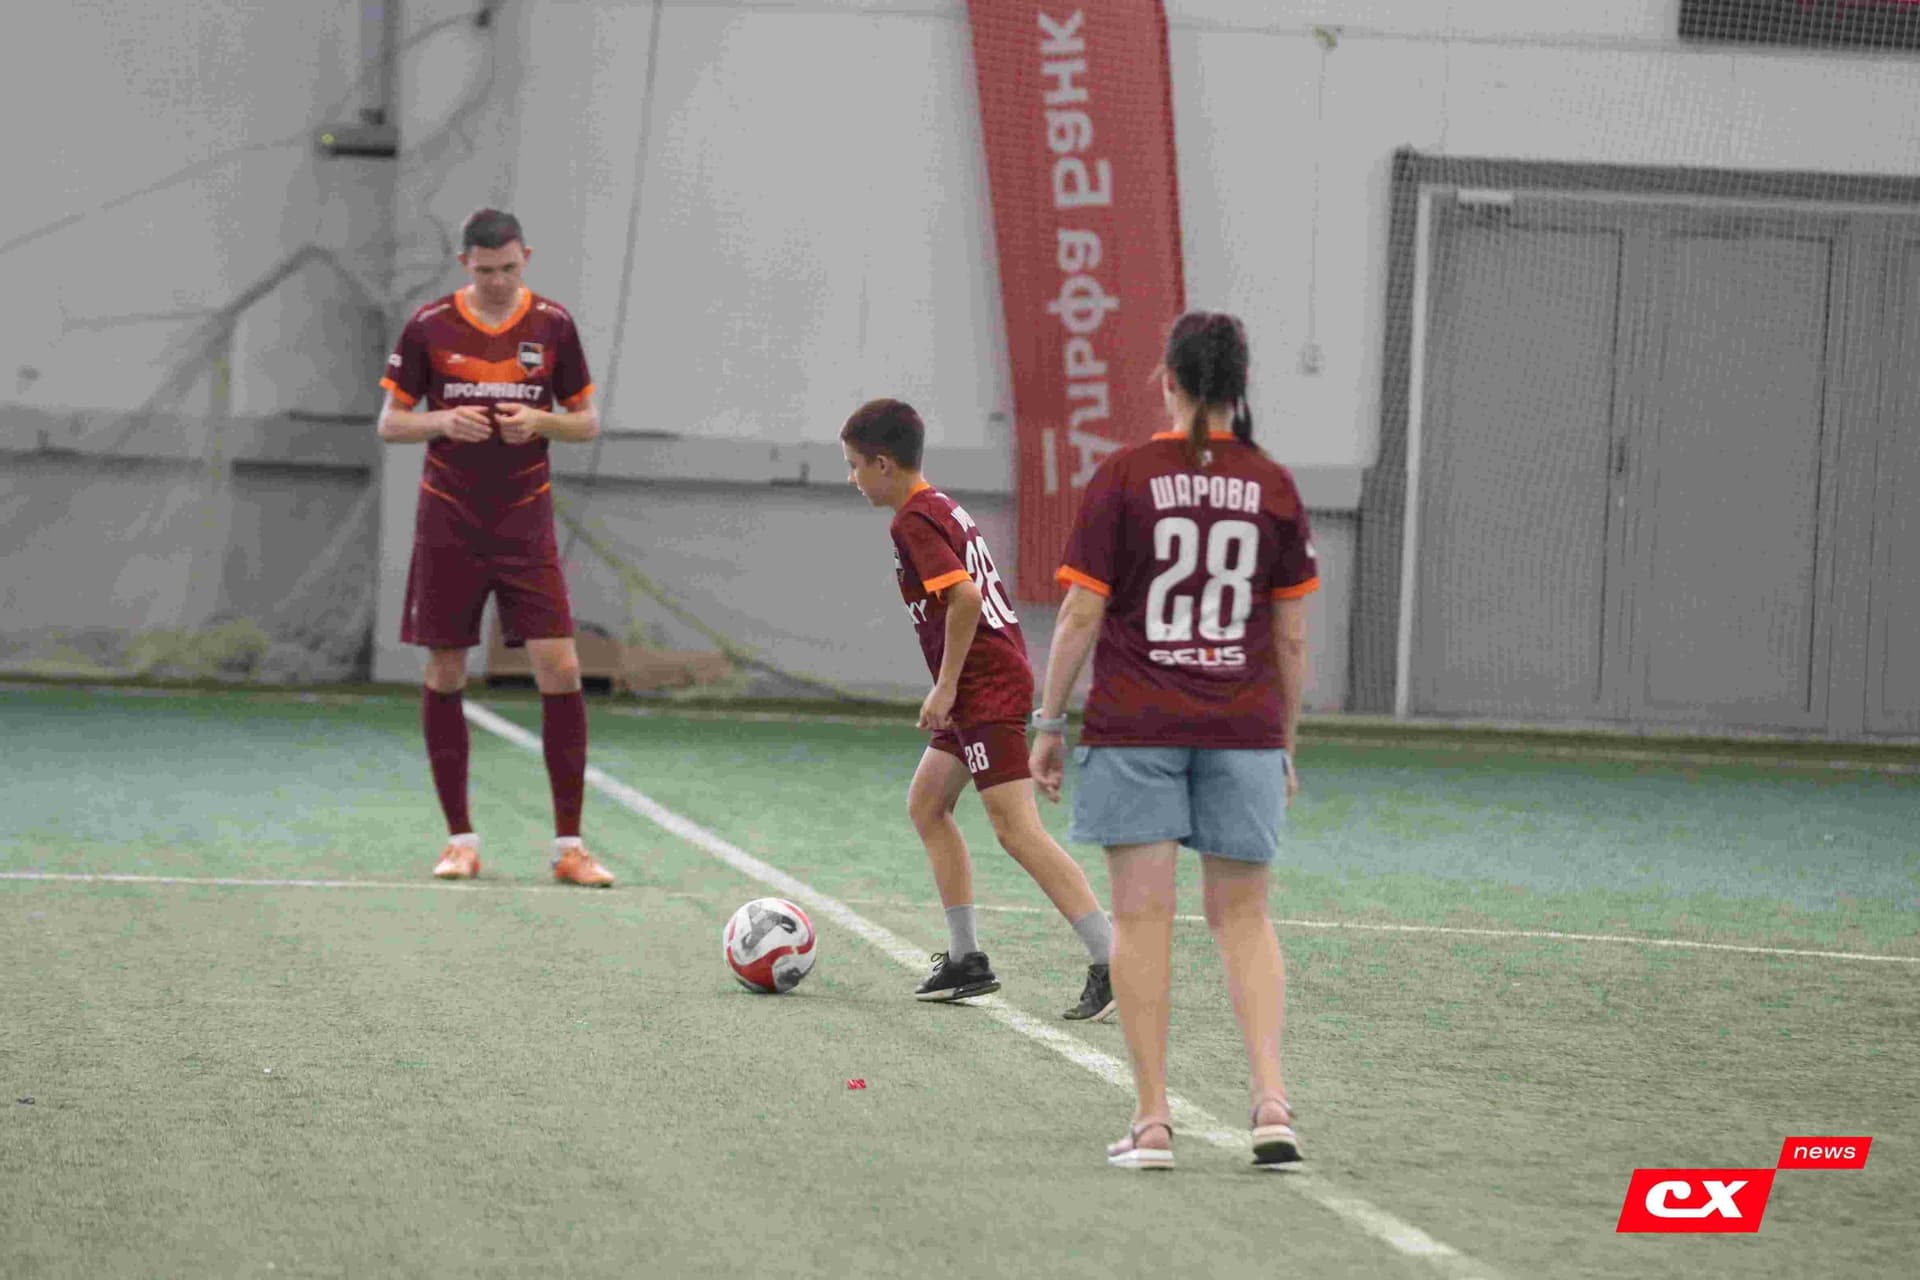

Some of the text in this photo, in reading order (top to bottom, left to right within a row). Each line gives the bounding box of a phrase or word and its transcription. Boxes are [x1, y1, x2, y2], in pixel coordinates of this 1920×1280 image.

[1150, 474, 1260, 514] ШАРОВА
[1146, 517, 1259, 641] 28
[964, 742, 990, 774] 28
